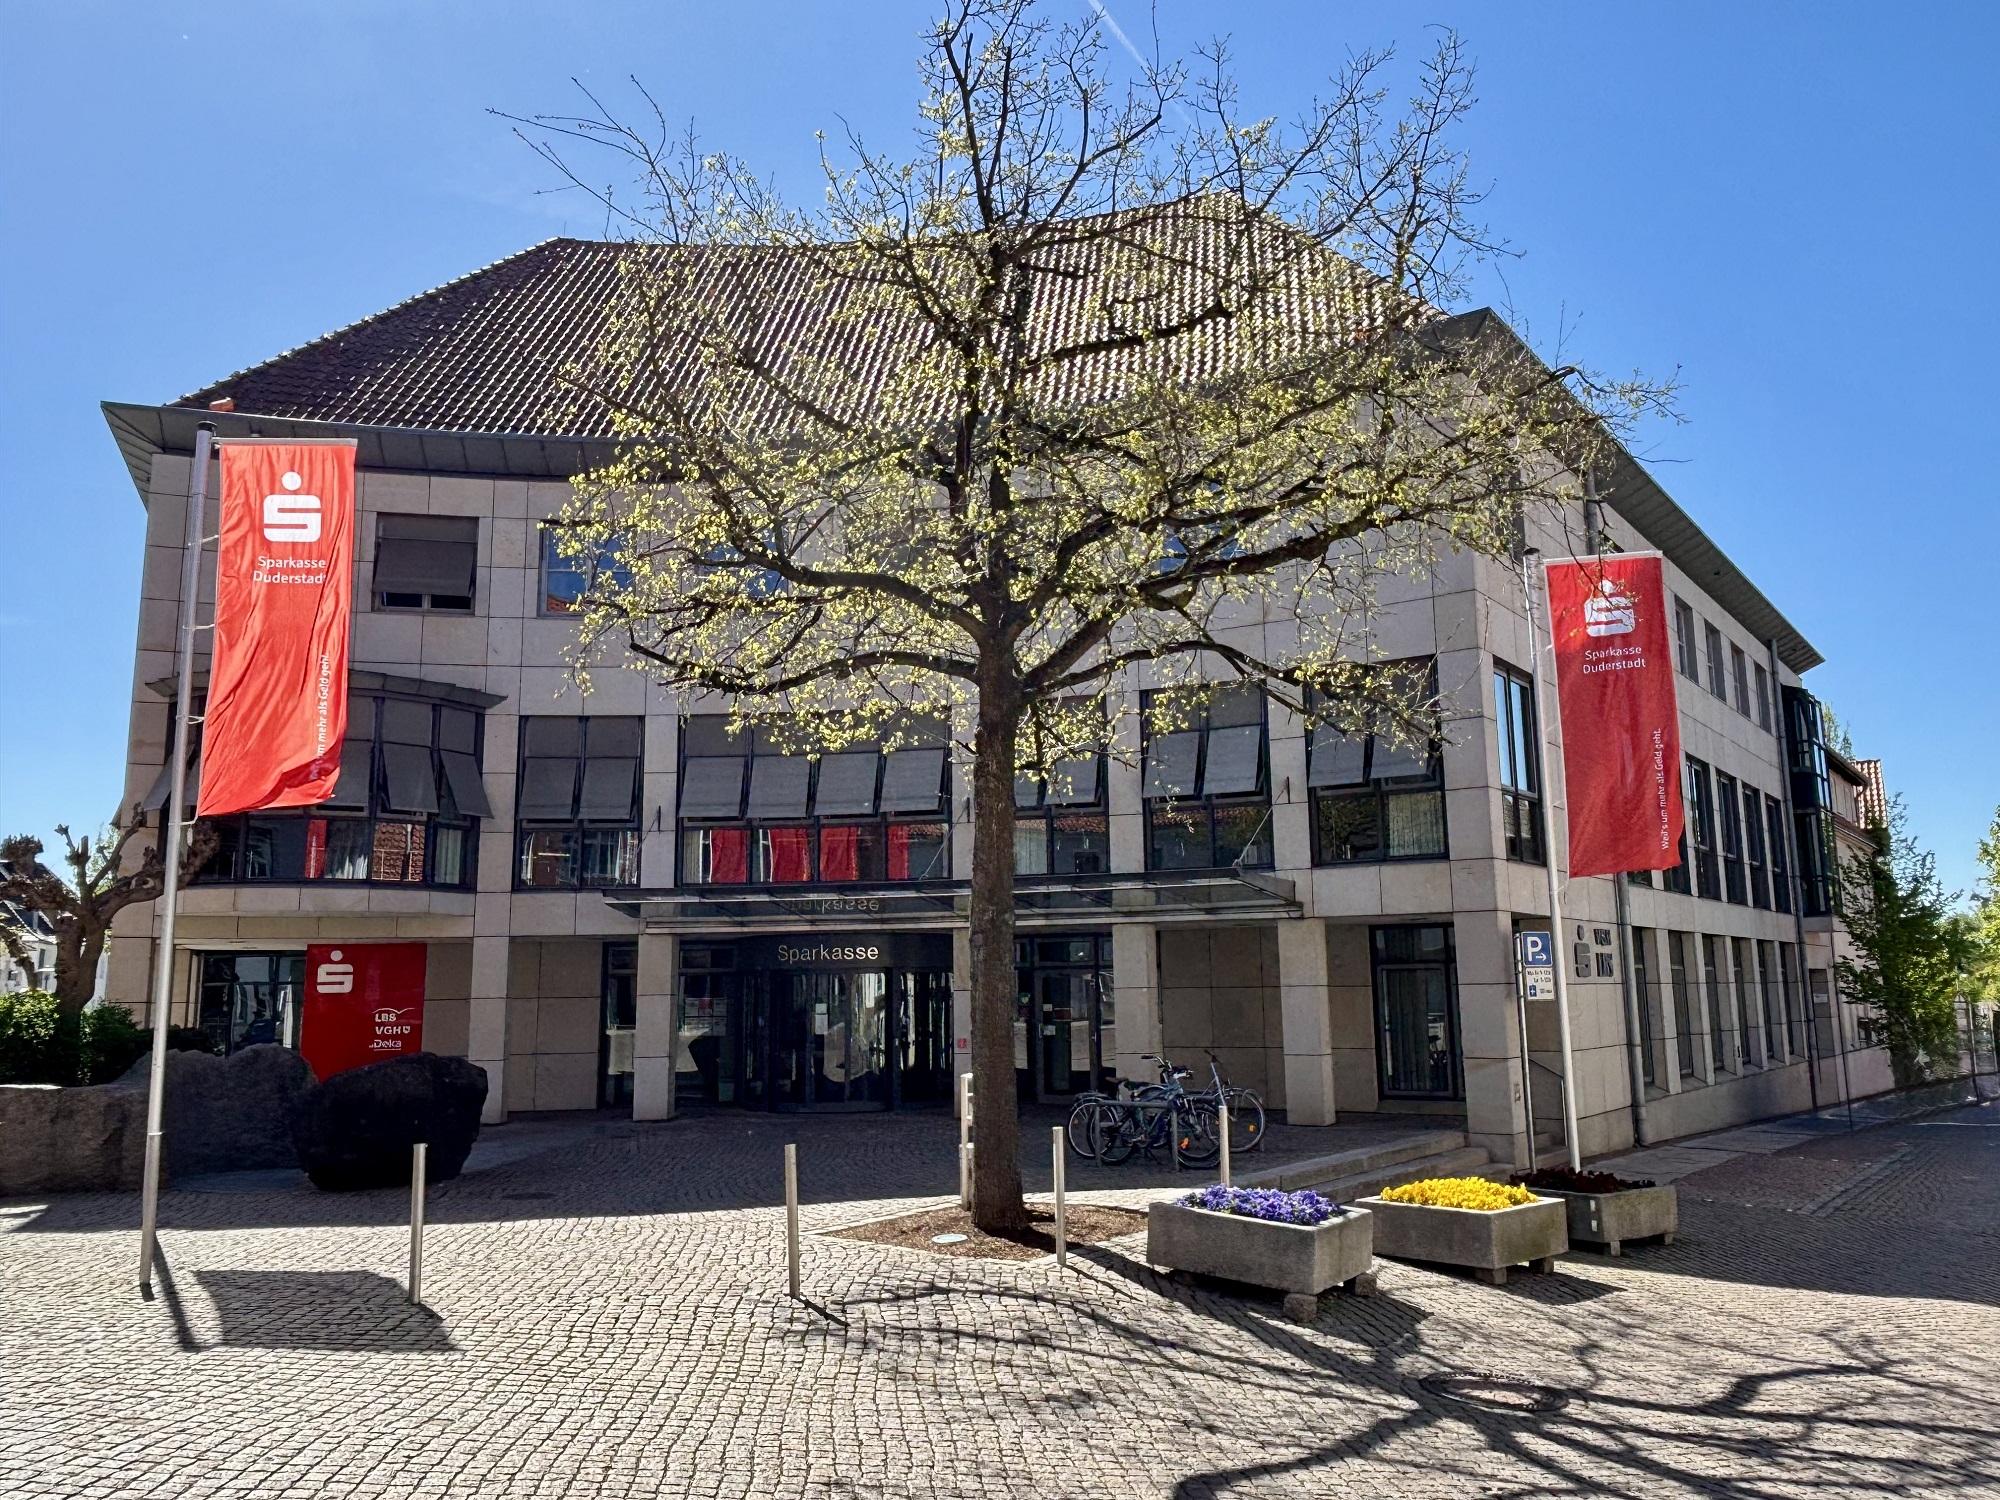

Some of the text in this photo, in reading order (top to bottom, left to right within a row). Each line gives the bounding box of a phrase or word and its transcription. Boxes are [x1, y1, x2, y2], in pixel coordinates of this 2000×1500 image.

[257, 555, 326, 570] Sparkasse
[1584, 646, 1642, 661] Sparkasse
[1583, 658, 1646, 675] Duderstadt
[318, 678, 329, 700] Geld
[317, 701, 327, 715] als
[316, 717, 327, 742] mehr
[778, 944, 879, 965] Sparkasse
[1527, 936, 1542, 961] P
[375, 1013, 397, 1022] LBS
[375, 1026, 401, 1035] VGH
[373, 1039, 402, 1048] Deka
